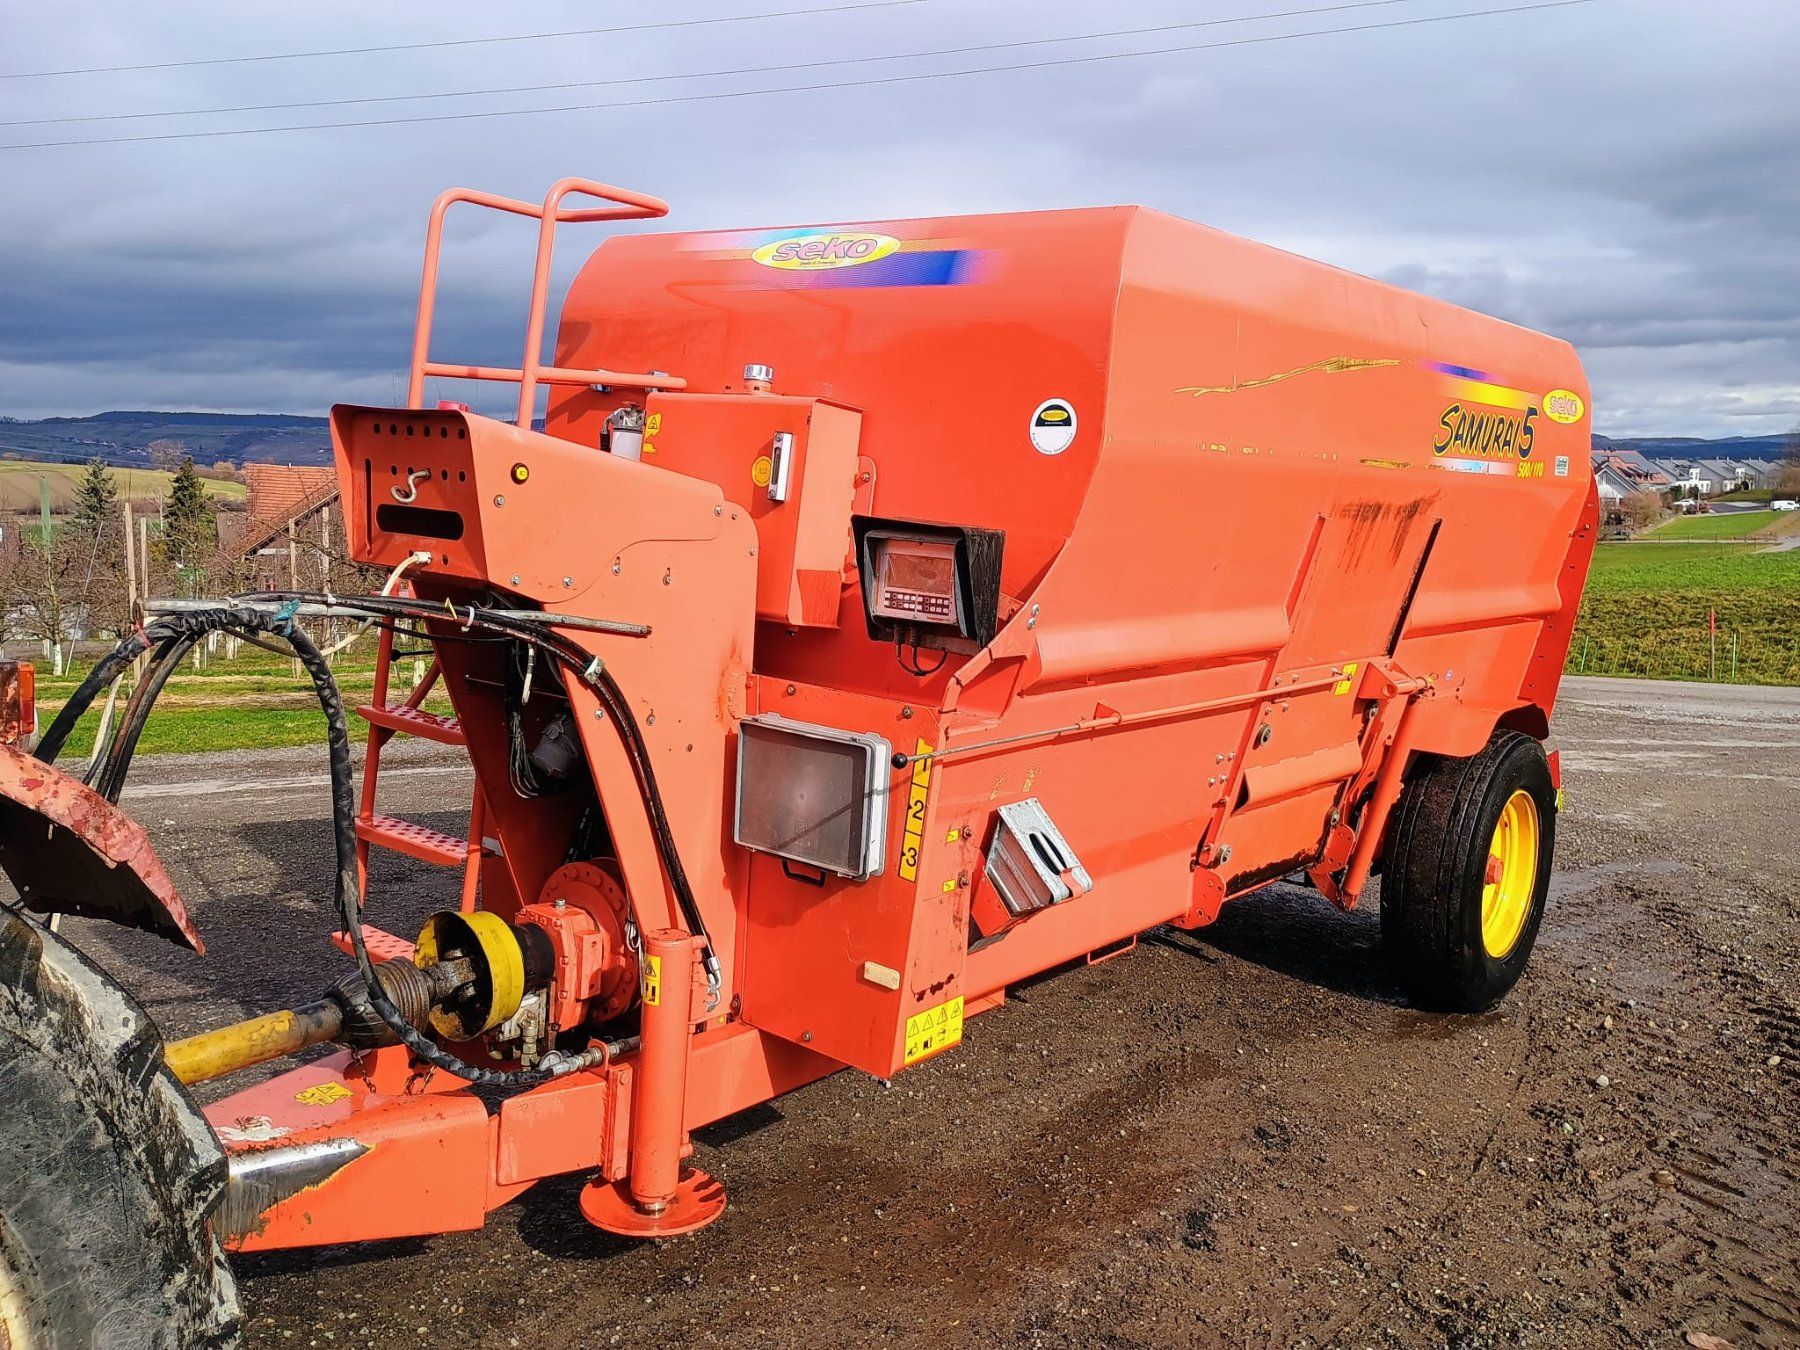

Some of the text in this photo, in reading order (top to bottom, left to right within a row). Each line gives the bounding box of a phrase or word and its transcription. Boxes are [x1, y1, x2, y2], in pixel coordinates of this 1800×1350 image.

[772, 237, 877, 261] seko
[1549, 394, 1577, 417] seko
[912, 799, 924, 820] 2
[905, 846, 917, 867] 3
